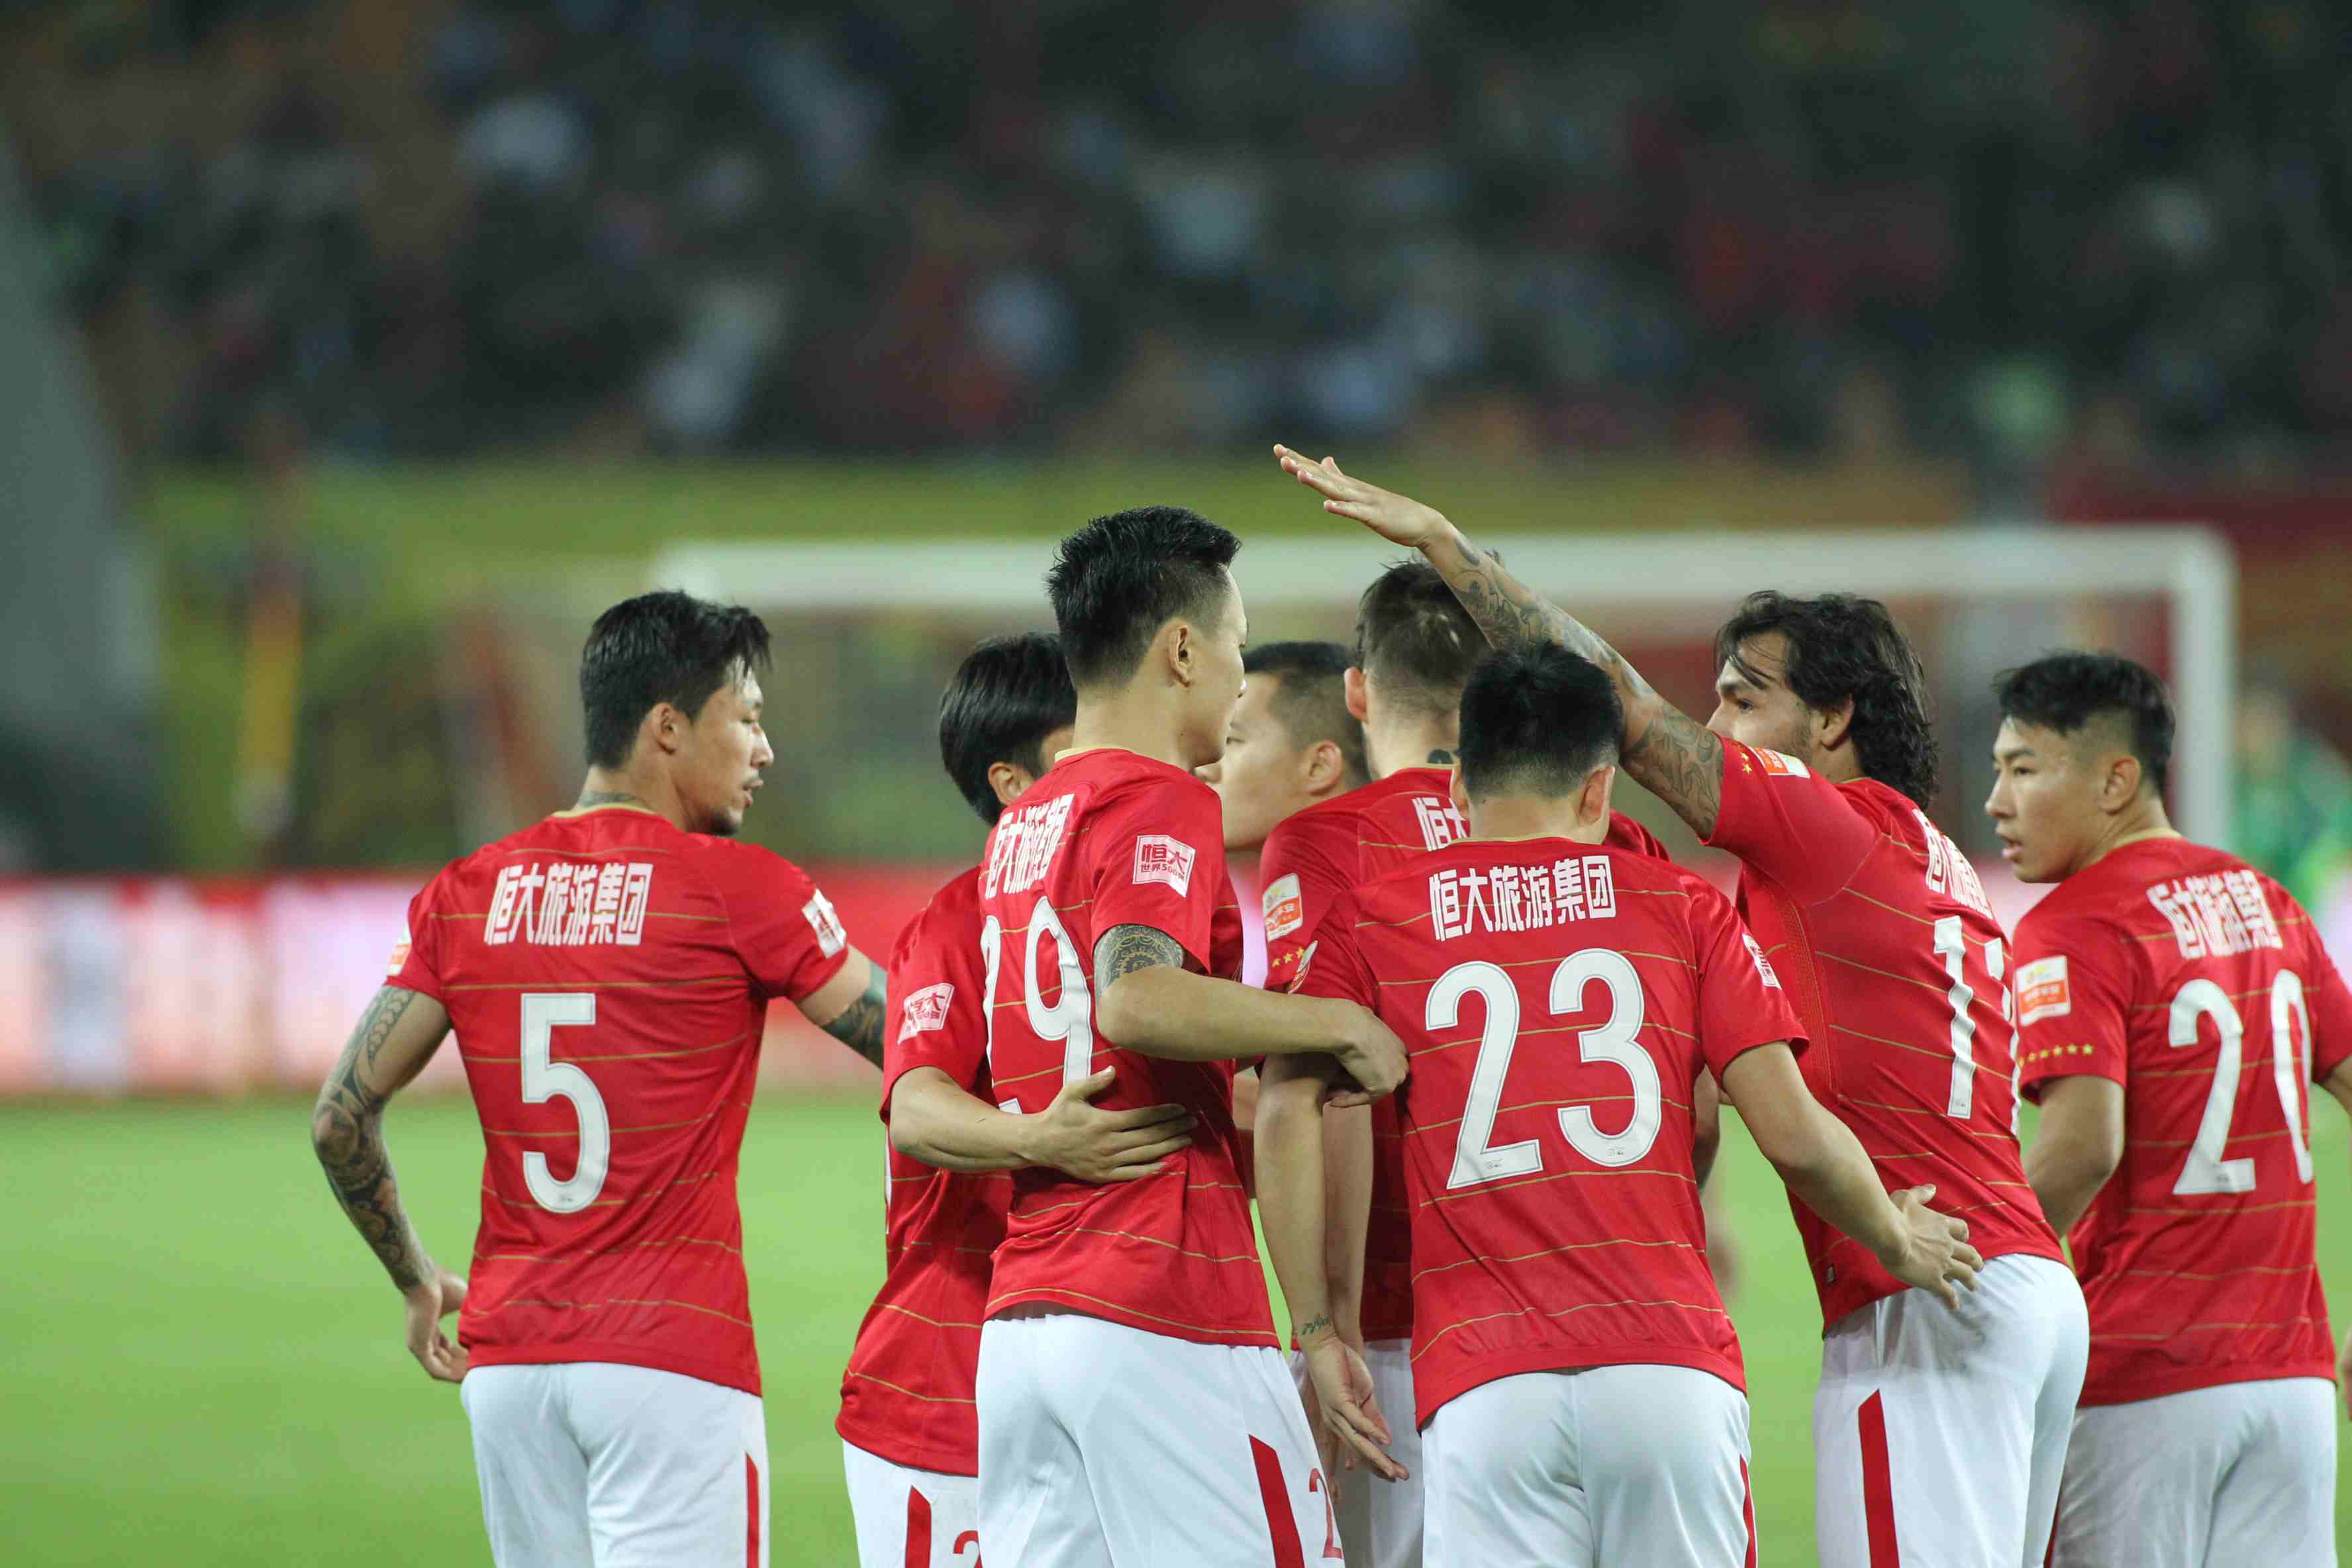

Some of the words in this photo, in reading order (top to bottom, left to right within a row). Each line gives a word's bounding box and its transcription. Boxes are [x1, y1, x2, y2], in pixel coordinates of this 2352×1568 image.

[483, 862, 654, 946] 恒大旅游集团
[1141, 844, 1189, 875] 恒大
[1428, 855, 1616, 942] 恒大旅游集团
[520, 993, 610, 1214] 5
[1426, 948, 1661, 1189] 23
[2169, 969, 2313, 1195] 20
